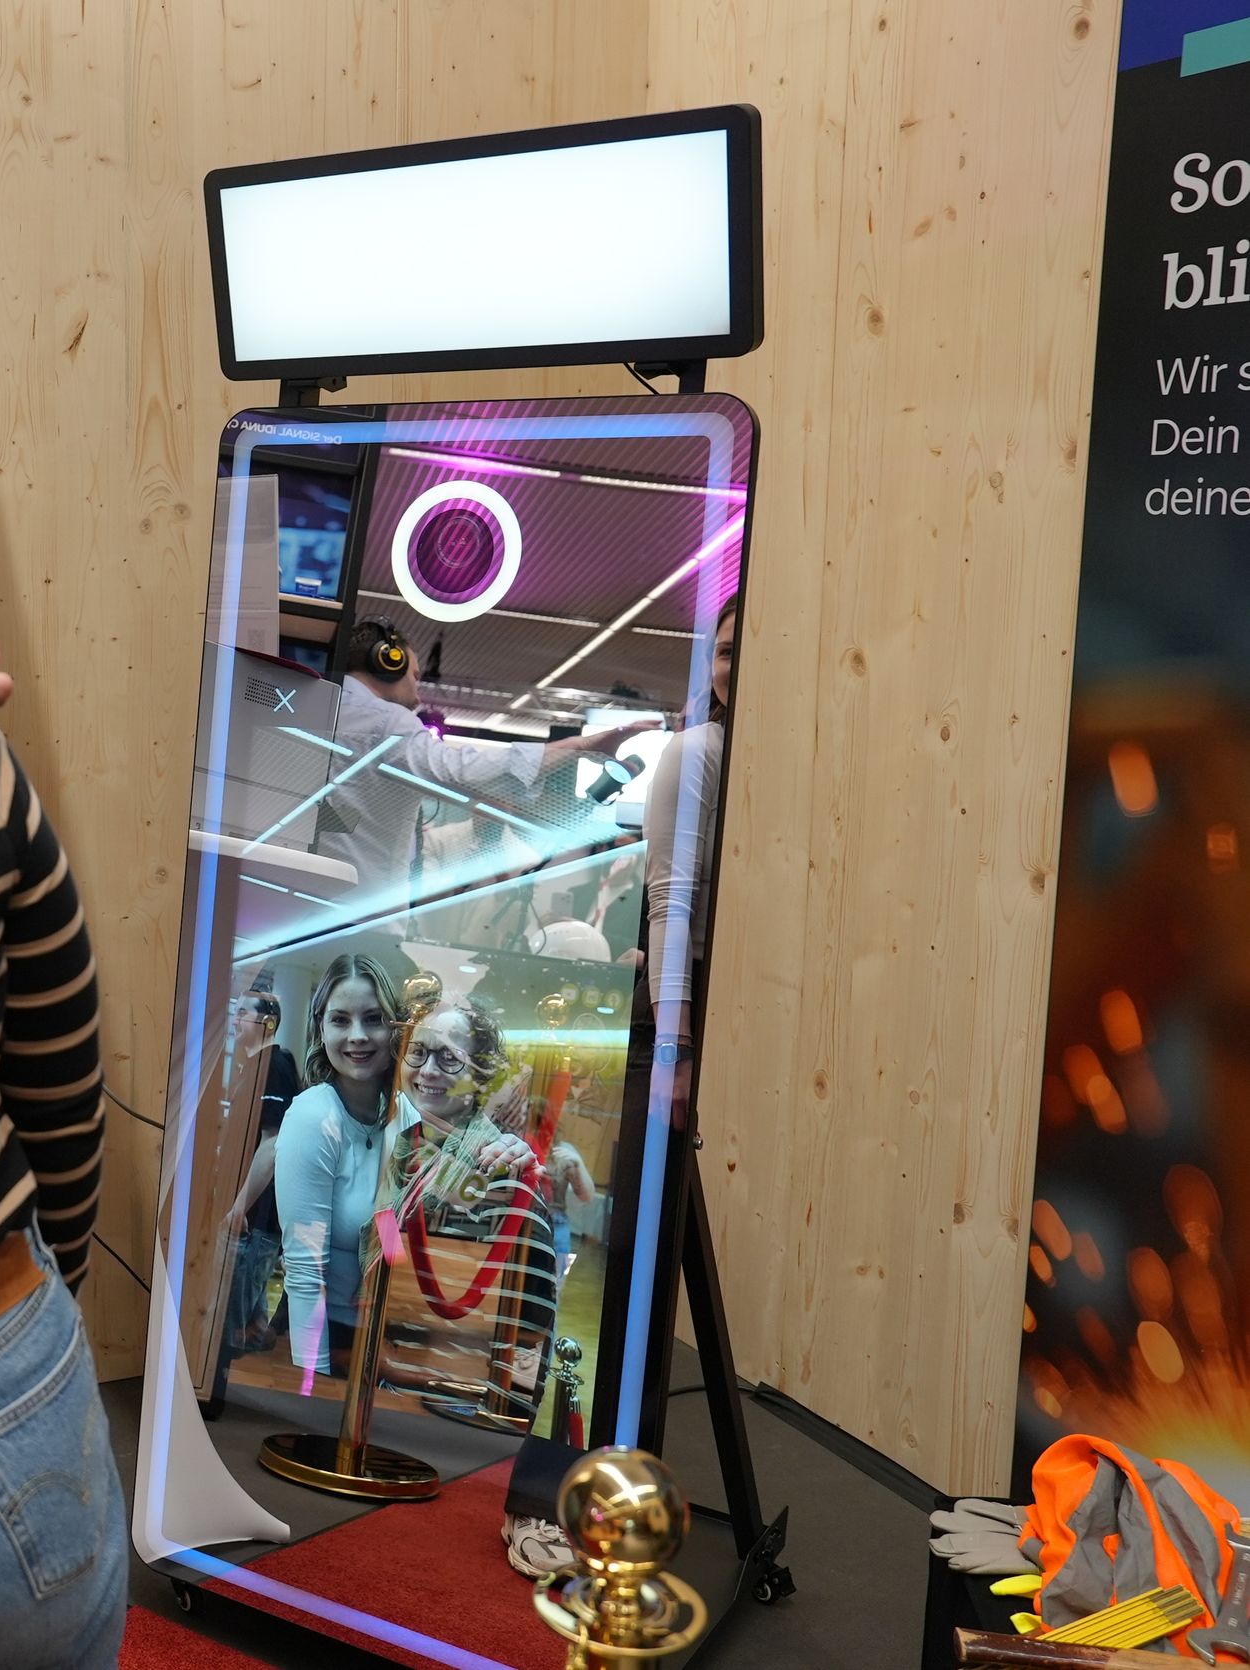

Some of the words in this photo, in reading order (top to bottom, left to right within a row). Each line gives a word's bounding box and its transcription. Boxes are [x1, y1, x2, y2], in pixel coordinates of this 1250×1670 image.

[1170, 152, 1250, 214] So
[1162, 239, 1250, 310] bli
[1156, 354, 1228, 396] Wir
[1151, 415, 1240, 456] Dein
